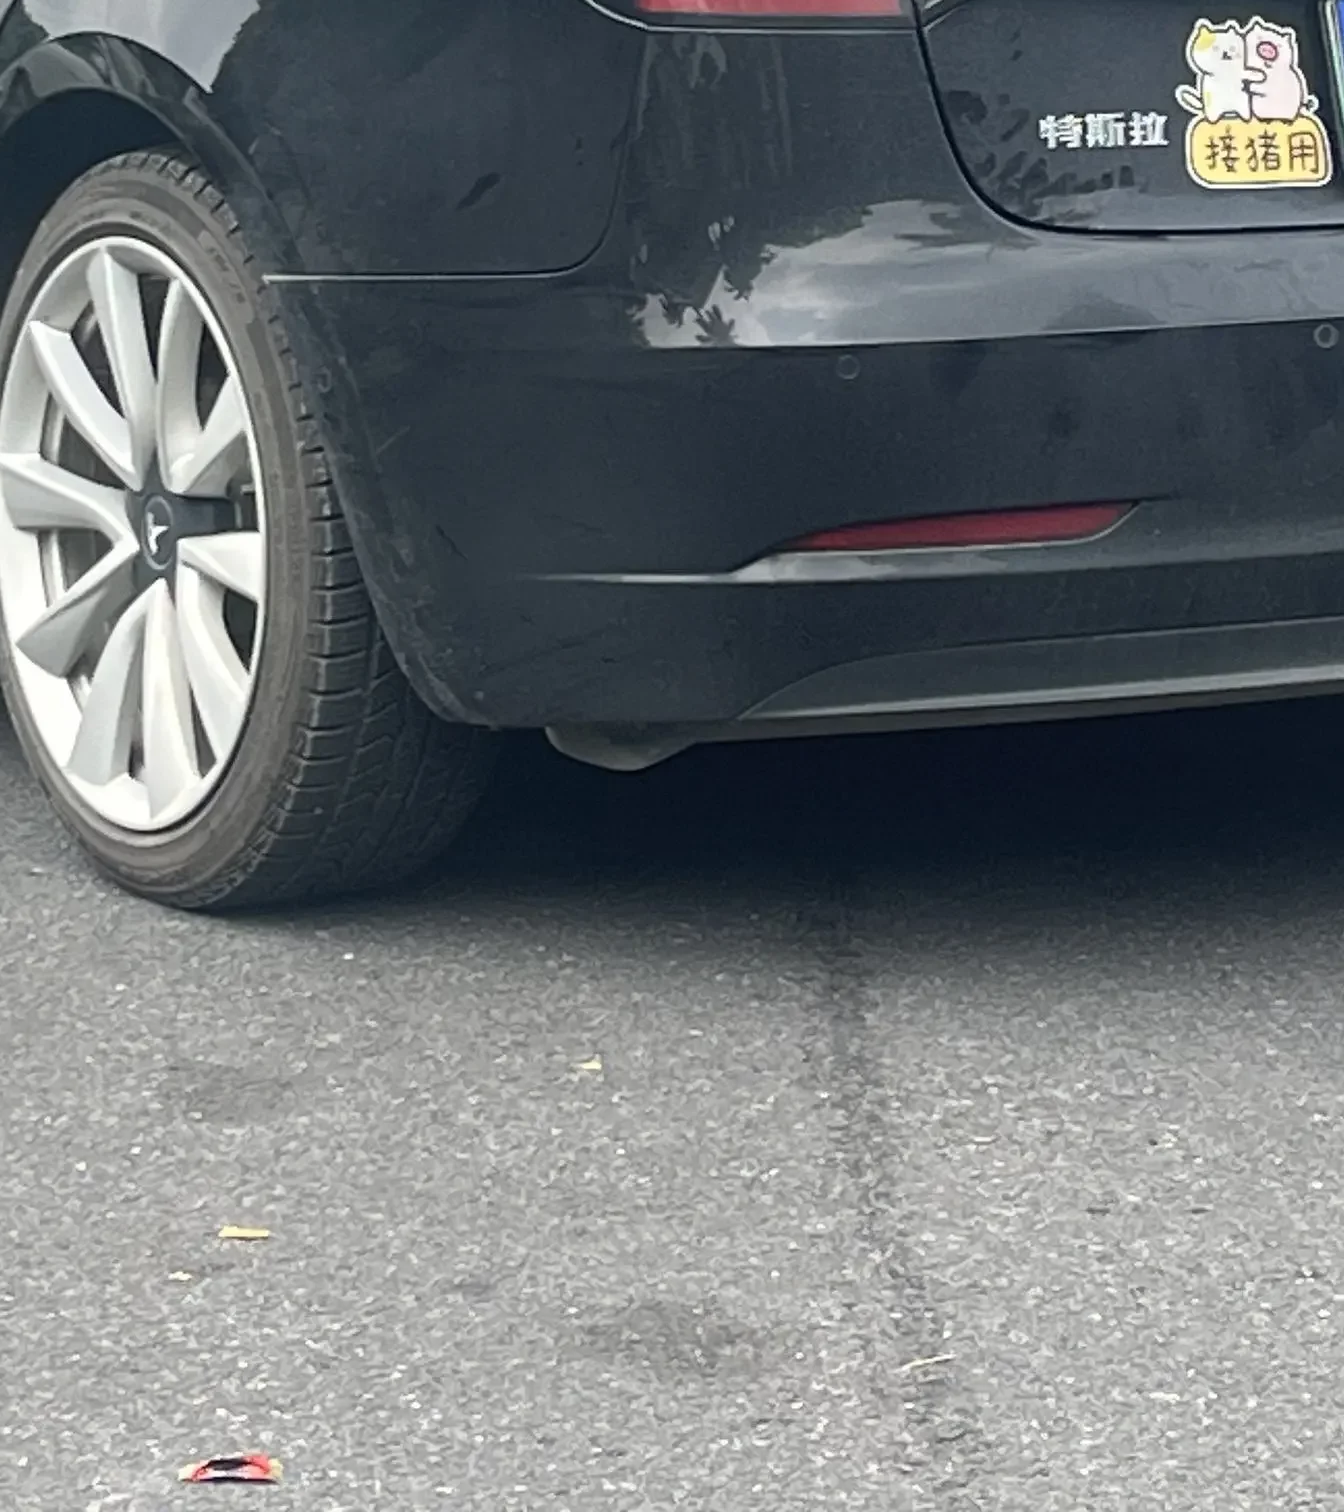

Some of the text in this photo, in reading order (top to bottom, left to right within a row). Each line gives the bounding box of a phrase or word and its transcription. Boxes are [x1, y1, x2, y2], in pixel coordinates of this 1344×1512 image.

[1038, 111, 1170, 149] 特斯拉
[1205, 126, 1320, 174] 接猪用
